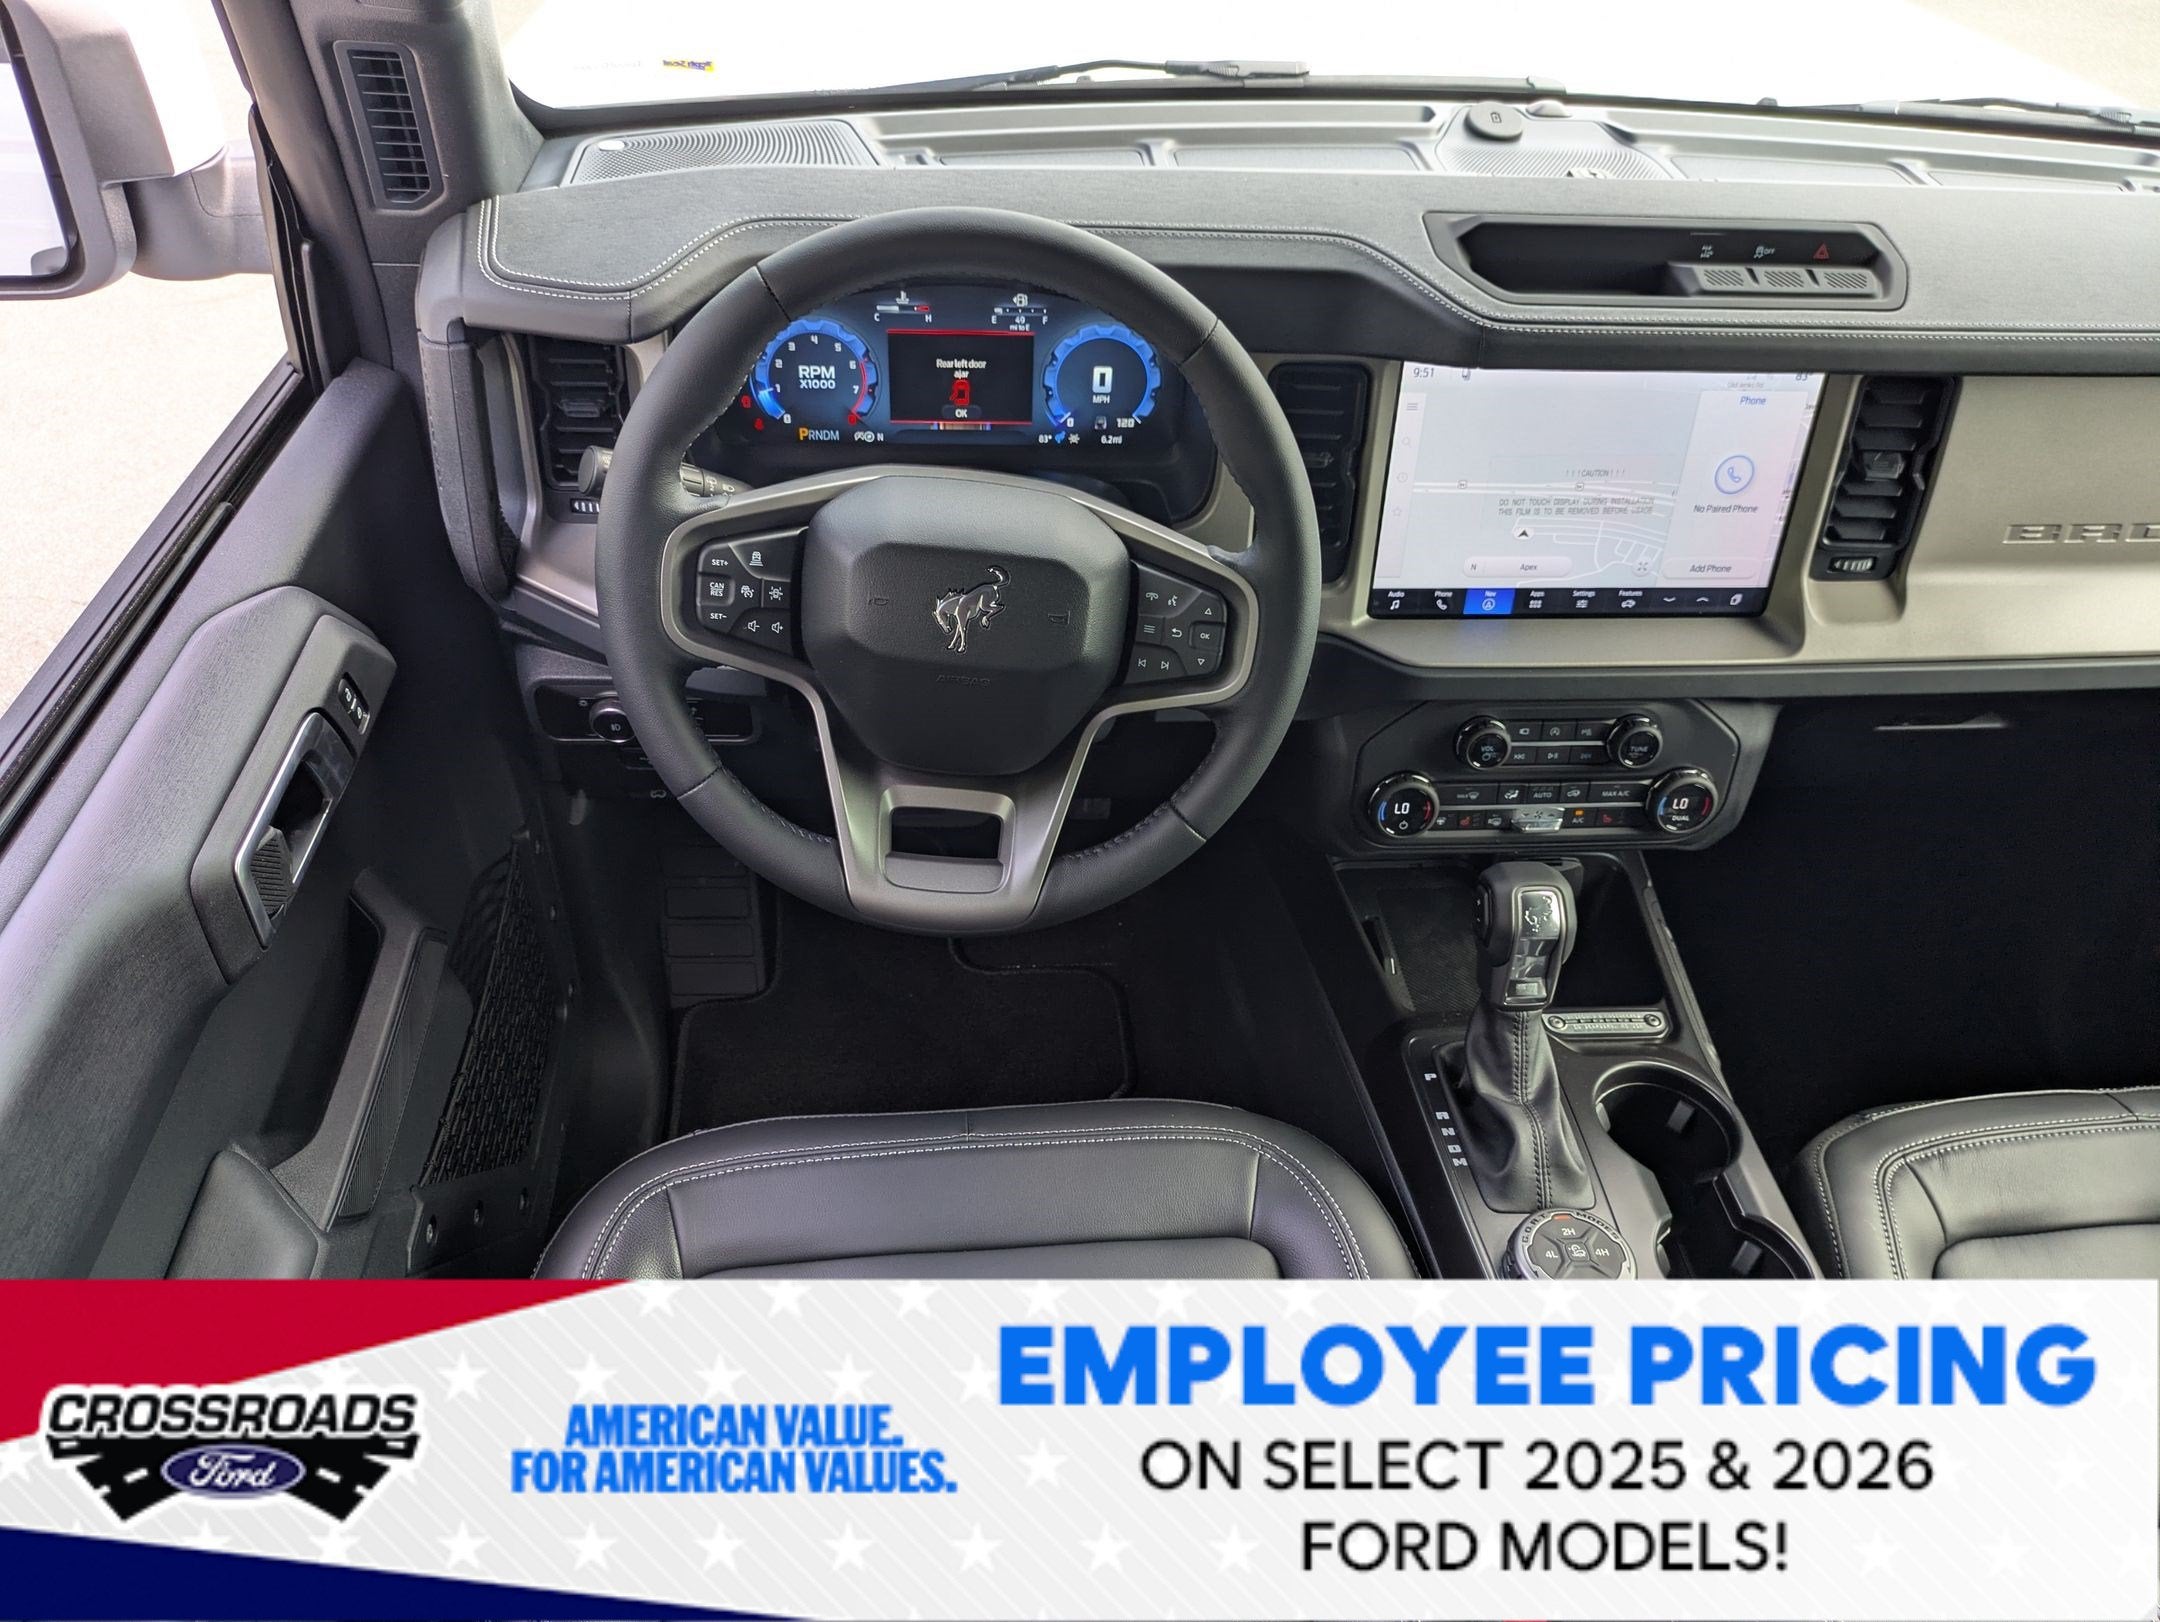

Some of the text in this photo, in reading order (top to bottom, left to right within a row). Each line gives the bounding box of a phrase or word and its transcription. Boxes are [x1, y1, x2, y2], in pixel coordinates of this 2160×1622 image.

[874, 313, 880, 322] C
[925, 314, 932, 322] H
[991, 315, 997, 324] E
[1042, 315, 1048, 325] F
[811, 335, 818, 344] 4
[788, 342, 796, 351] 3
[834, 342, 841, 352] 5
[775, 359, 782, 368] 2
[936, 358, 987, 368] Rear left door
[798, 365, 835, 379] RPM
[954, 369, 969, 379] ajar
[1414, 368, 1434, 378] 9:51
[1092, 366, 1113, 393] 0
[800, 380, 835, 389] X1000
[853, 385, 859, 394] 7
[1092, 395, 1110, 404] MPH
[1739, 395, 1766, 405] Phone
[955, 408, 968, 418] OK
[783, 414, 791, 424] 0
[1066, 417, 1074, 428] 0
[1116, 418, 1135, 428] 120
[799, 428, 840, 440] PRNDM
[877, 433, 884, 441] N
[1693, 505, 1758, 513] No Paired Phone
[1690, 564, 1732, 573] Add Phone
[710, 589, 723, 597] RES
[1530, 590, 1545, 598] Apps
[1572, 590, 1595, 598] Settings
[1672, 798, 1689, 810] LO
[1394, 803, 1410, 815] LO
[1424, 1073, 1437, 1081] P
[1436, 1111, 1449, 1120] R
[1442, 1128, 1455, 1136] N
[1448, 1145, 1462, 1153] D
[1453, 1158, 1468, 1166] M
[1575, 1212, 1620, 1239] MODES
[1561, 1228, 1575, 1236] 2H
[1545, 1250, 1558, 1258] 4L
[1595, 1248, 1610, 1256] 4H
